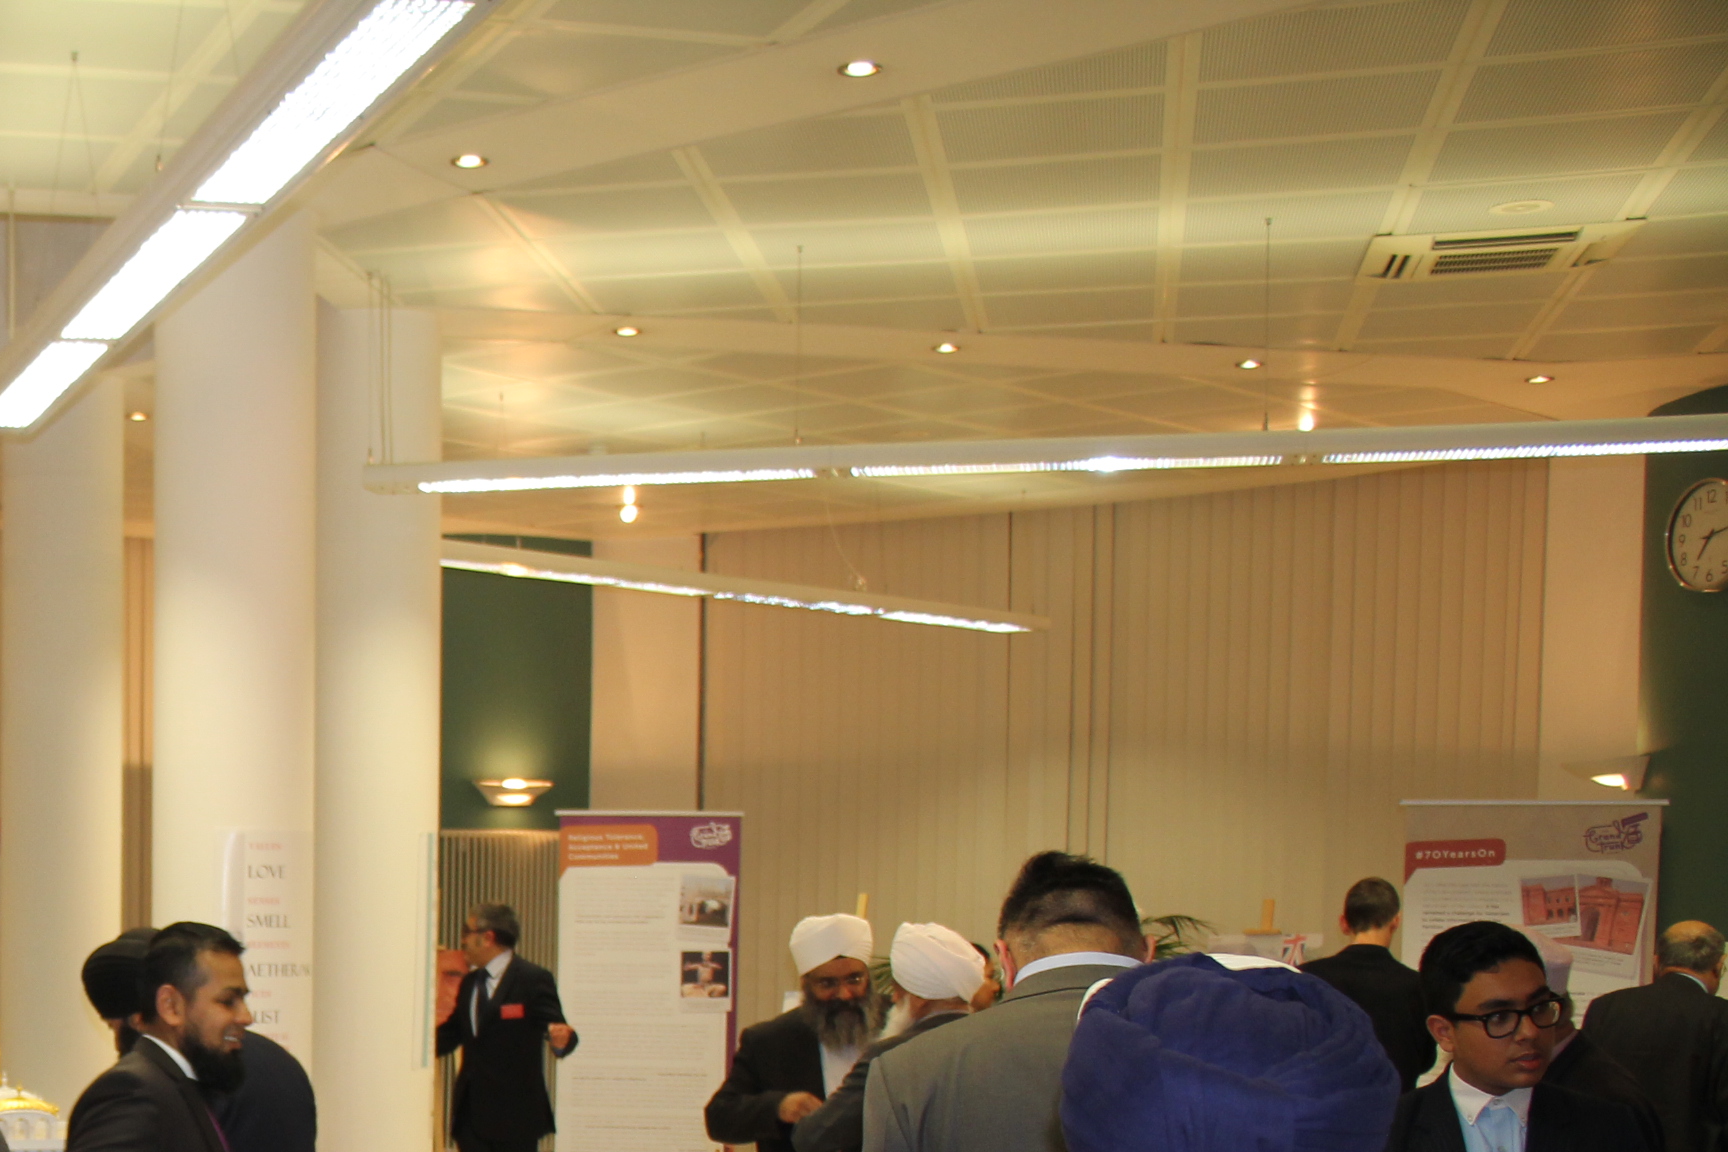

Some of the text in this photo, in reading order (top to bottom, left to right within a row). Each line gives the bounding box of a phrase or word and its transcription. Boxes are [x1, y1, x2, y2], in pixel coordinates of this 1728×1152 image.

[1707, 489, 1717, 504] 12
[1694, 497, 1703, 512] 11
[1682, 513, 1692, 528] 10
[1678, 534, 1686, 548] 9
[1680, 552, 1688, 567] 8
[1693, 565, 1700, 579] 7
[1721, 560, 1728, 575] 5
[1705, 568, 1713, 583] 6
[248, 864, 285, 879] LOVE
[246, 914, 291, 928] SMELL
